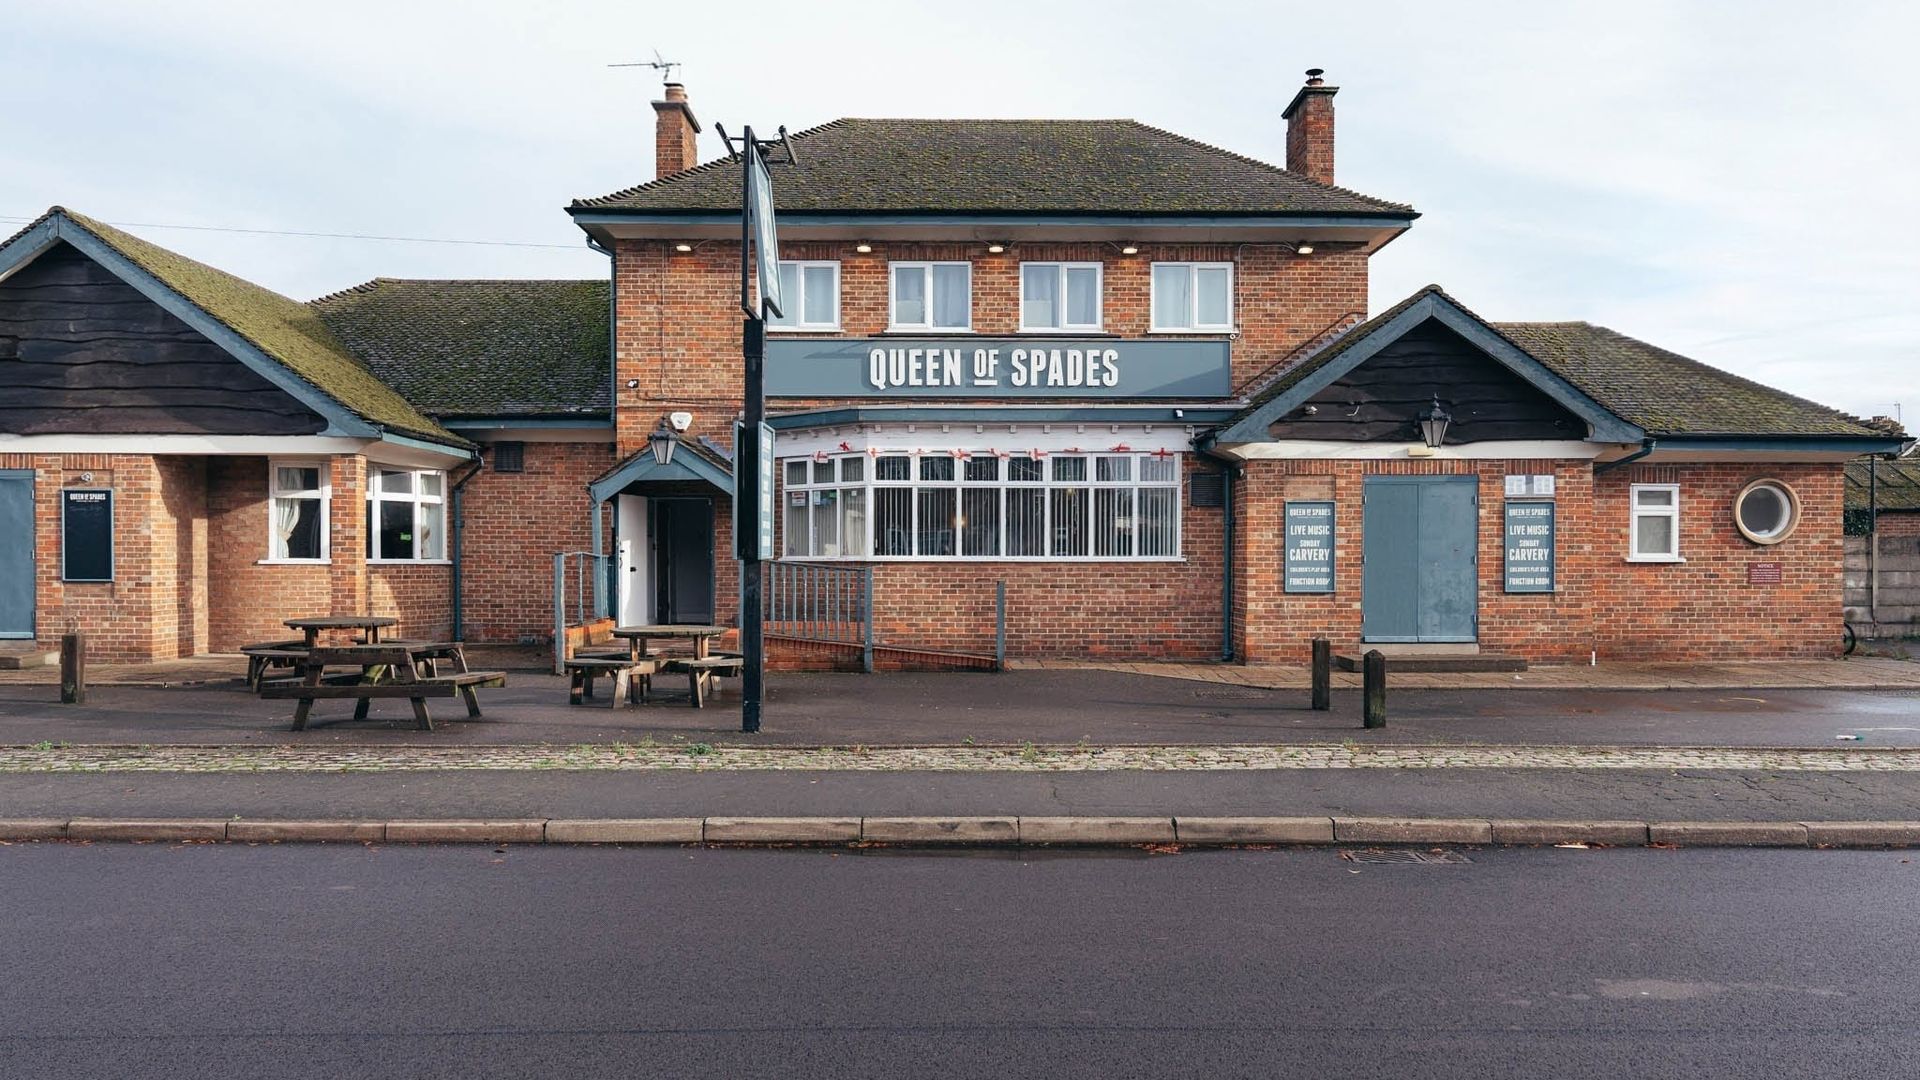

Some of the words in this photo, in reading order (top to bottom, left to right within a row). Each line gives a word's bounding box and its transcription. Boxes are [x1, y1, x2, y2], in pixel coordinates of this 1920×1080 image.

[870, 349, 961, 390] QUEEN
[974, 349, 999, 386] OF
[1011, 349, 1119, 387] SPADES
[1289, 508, 1306, 516] QUEEN
[1312, 508, 1331, 516] SPADES
[1508, 508, 1525, 516] QUEEN
[1531, 508, 1550, 516] SPADES
[1290, 525, 1307, 536] LIVE
[1307, 525, 1330, 536] MUSIC
[1509, 525, 1526, 536] LIVE
[1526, 525, 1550, 536] MUSIC
[1300, 539, 1320, 547] SUNDAY
[1519, 539, 1539, 547] SUNDAY
[1289, 548, 1330, 561] CARVERY
[1509, 548, 1549, 561] CARVERY
[1289, 577, 1316, 586] FUNCTION
[1316, 577, 1331, 586] ROOM
[1508, 577, 1534, 586] FUNCTION
[1535, 577, 1550, 586] ROOM
